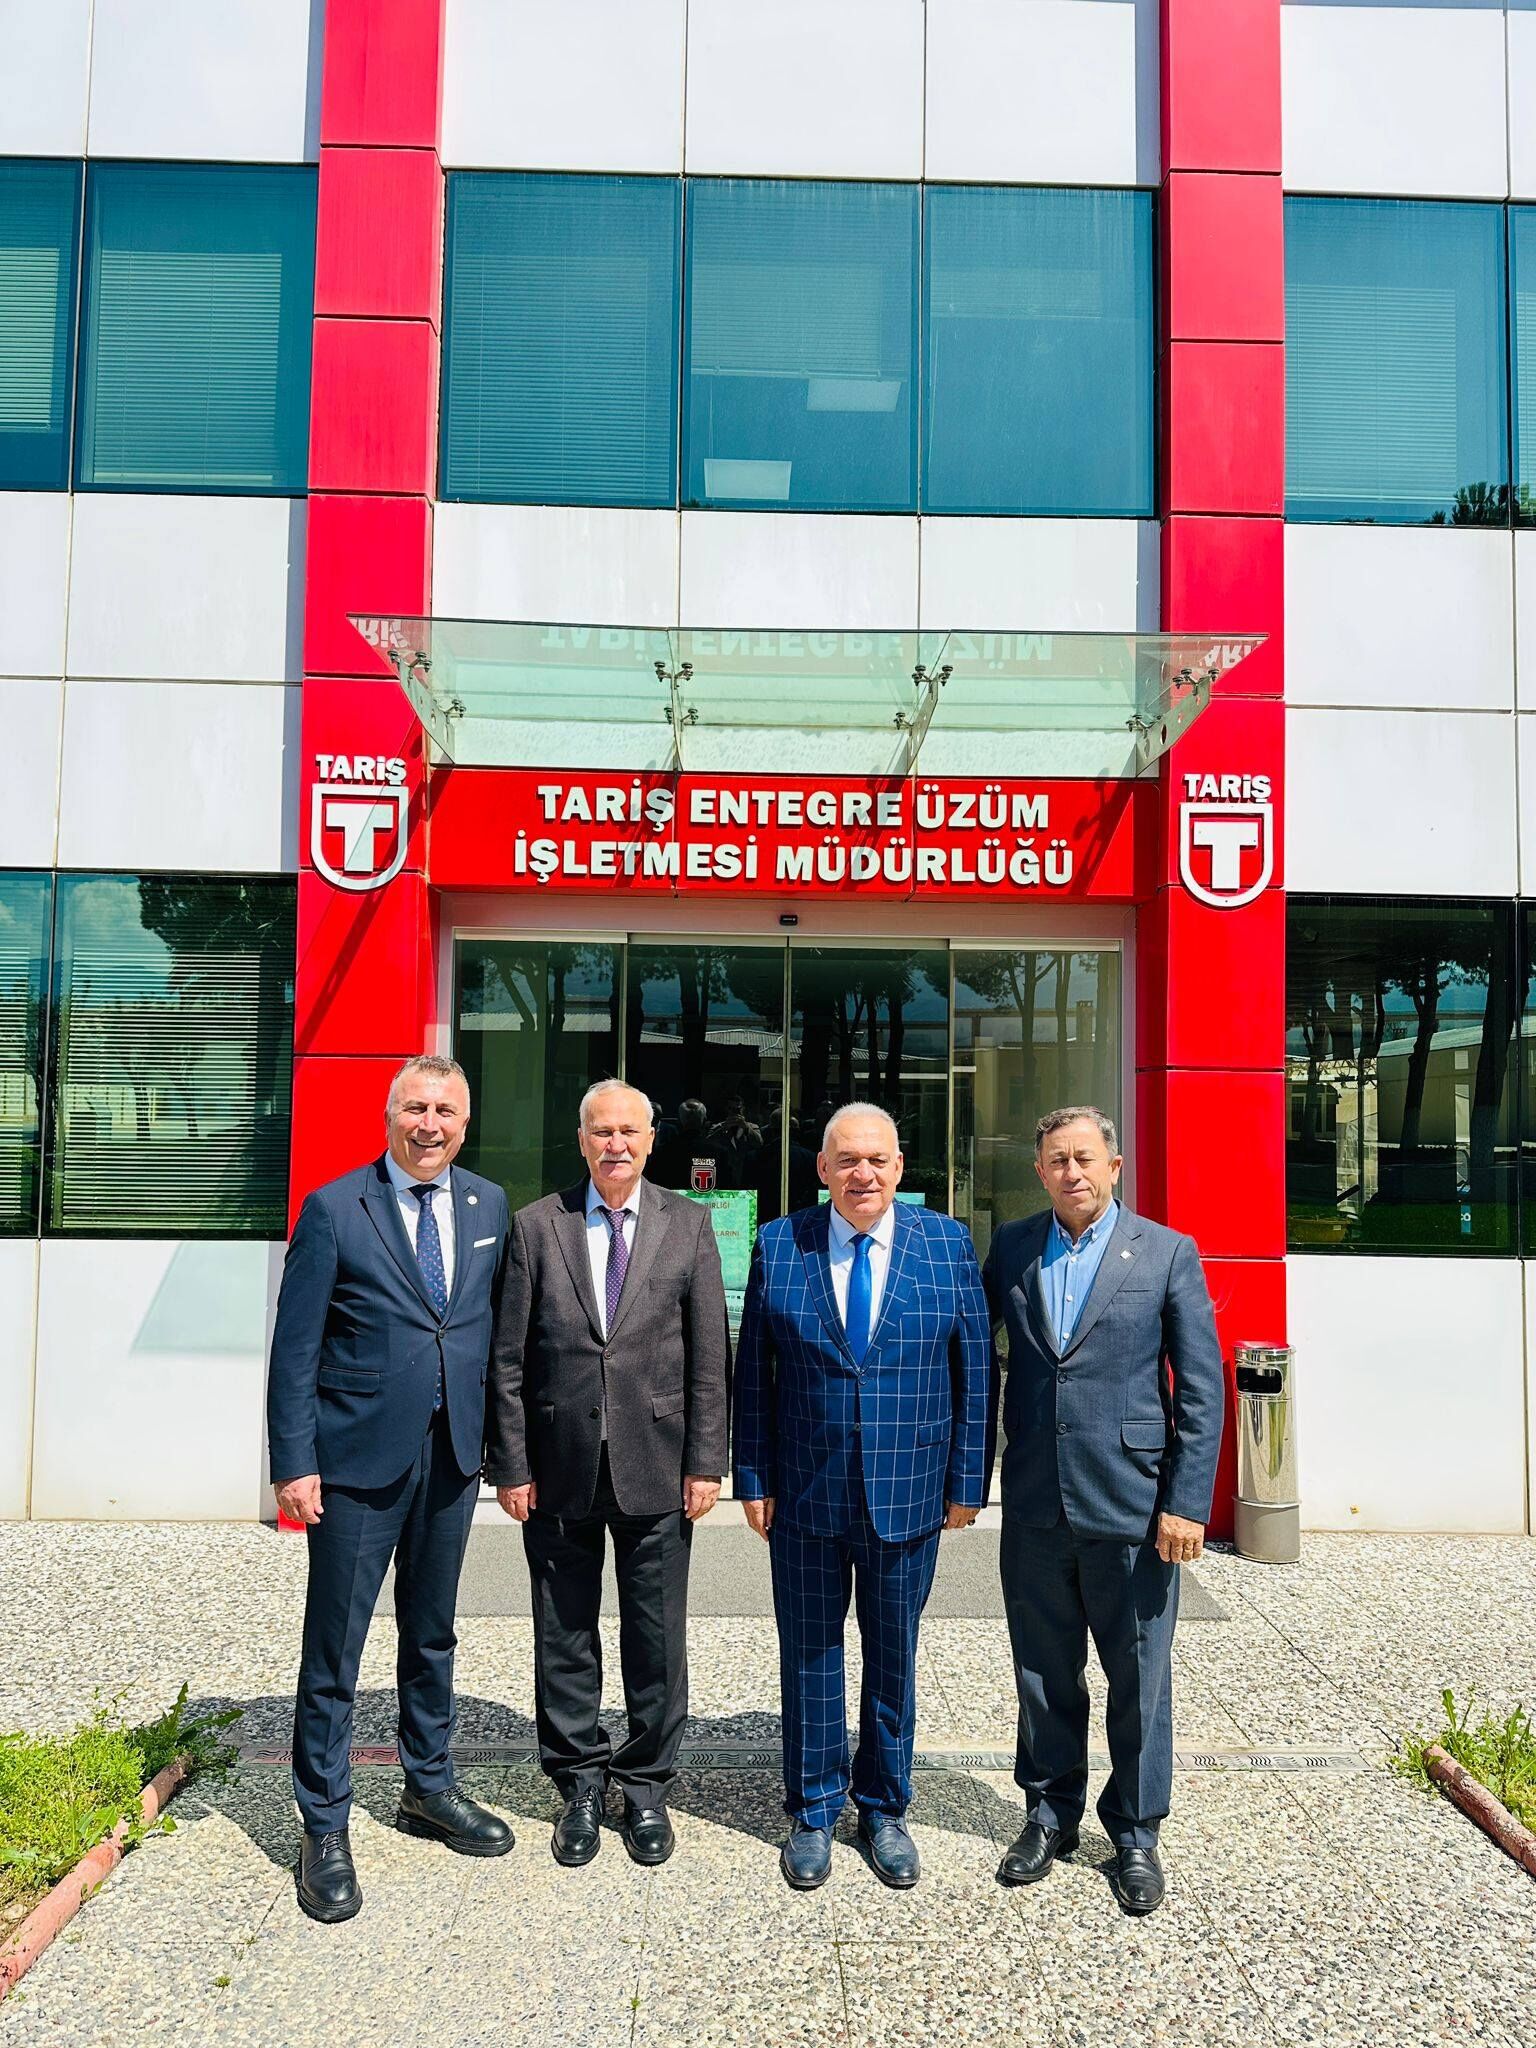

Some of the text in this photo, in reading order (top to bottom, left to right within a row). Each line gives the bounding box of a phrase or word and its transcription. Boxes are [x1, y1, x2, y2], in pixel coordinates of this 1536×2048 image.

[537, 778, 1050, 832] TARİŞ ENTEGRE ÜZÜM
[513, 830, 1073, 885] İŞLETMESİ MÜDÜRLÜĞÜ
